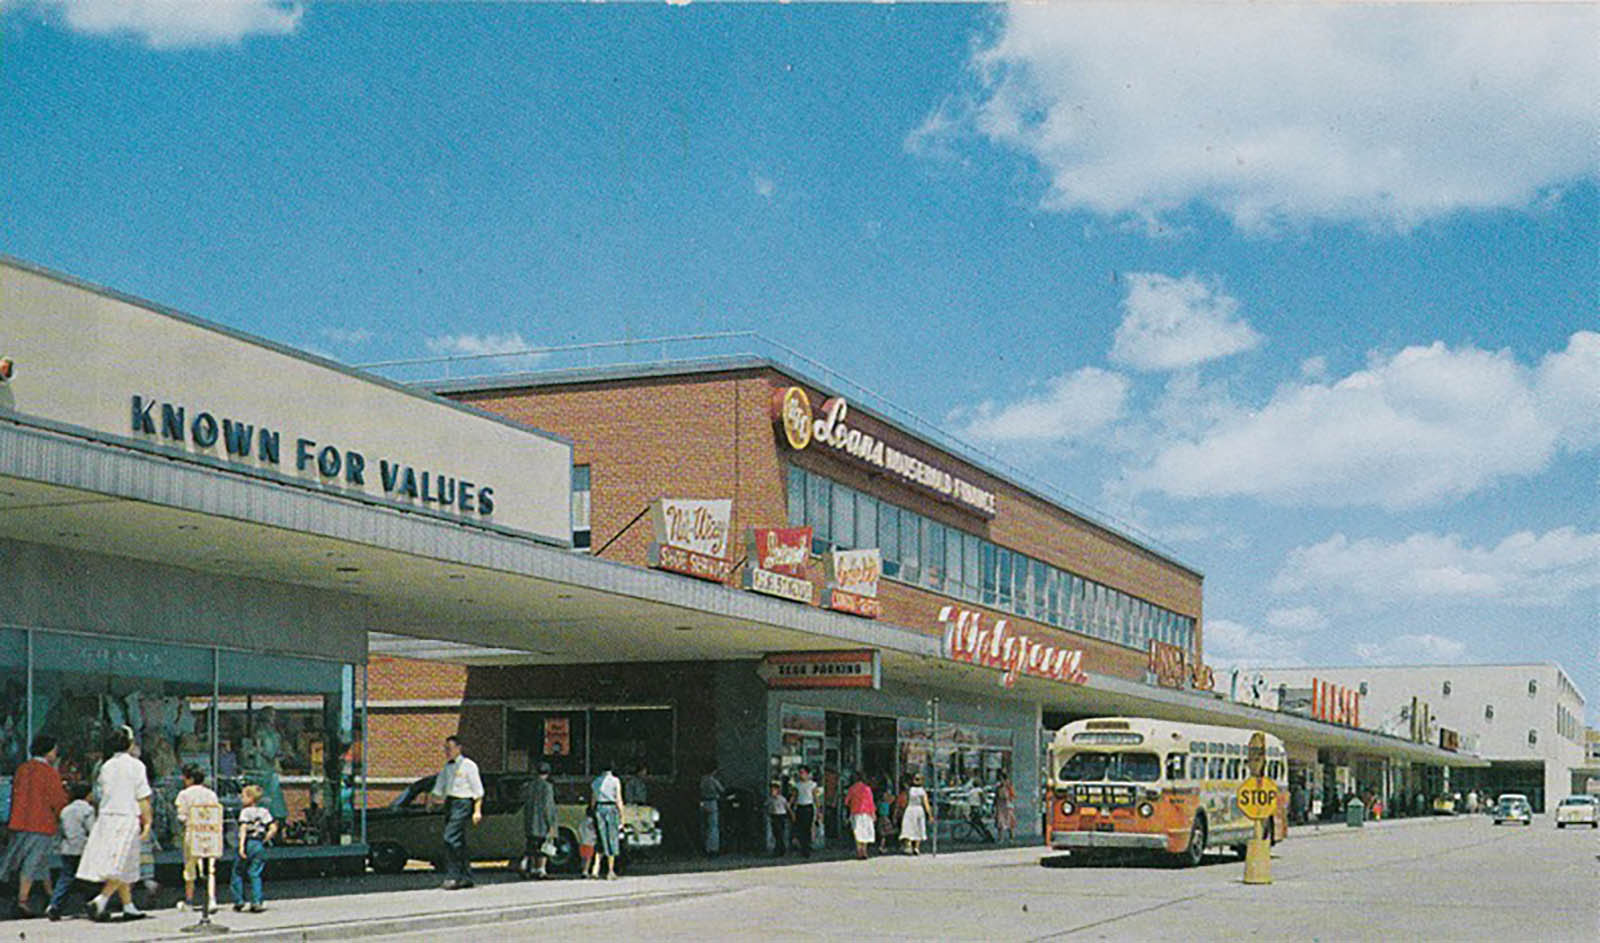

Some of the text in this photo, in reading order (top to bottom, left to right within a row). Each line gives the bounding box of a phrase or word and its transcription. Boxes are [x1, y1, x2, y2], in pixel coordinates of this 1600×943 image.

[131, 395, 494, 516] KNOWN FOR VALUES
[1240, 789, 1277, 806] STOP
